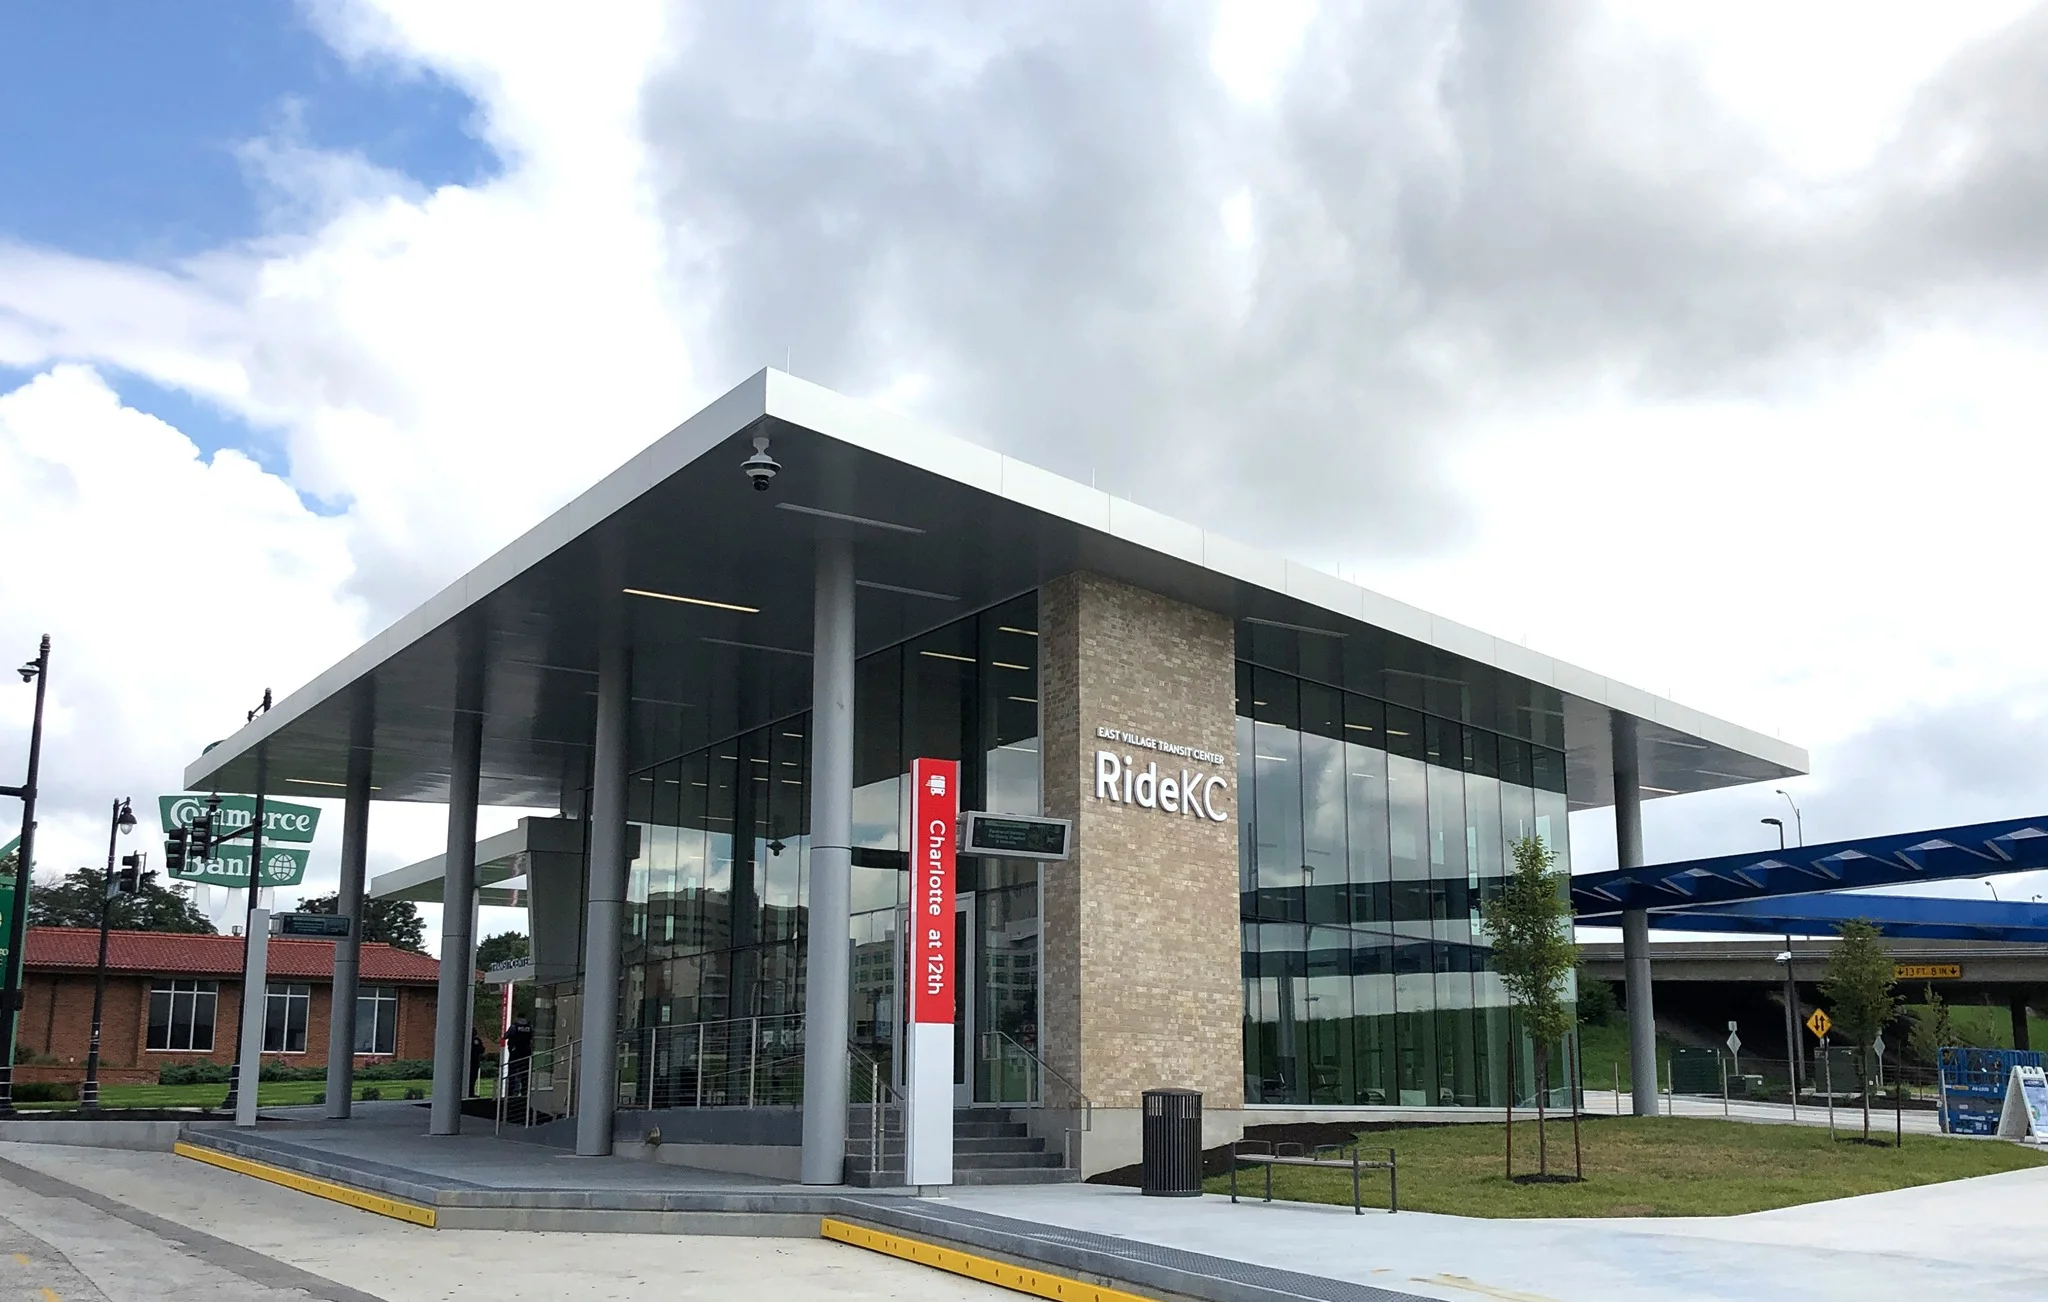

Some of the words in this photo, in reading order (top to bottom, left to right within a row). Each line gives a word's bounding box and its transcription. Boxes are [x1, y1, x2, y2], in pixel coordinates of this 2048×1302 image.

[1097, 727, 1121, 741] EAST
[1122, 732, 1157, 750] VILLAGE
[1158, 740, 1193, 757] TRANSIT
[1193, 749, 1225, 765] CENTER
[1095, 750, 1229, 822] RideKC
[928, 820, 946, 916] Charlotte
[928, 929, 942, 949] at
[927, 954, 944, 995] 12th
[1905, 968, 1915, 977] 13
[1930, 967, 1937, 977] 8
